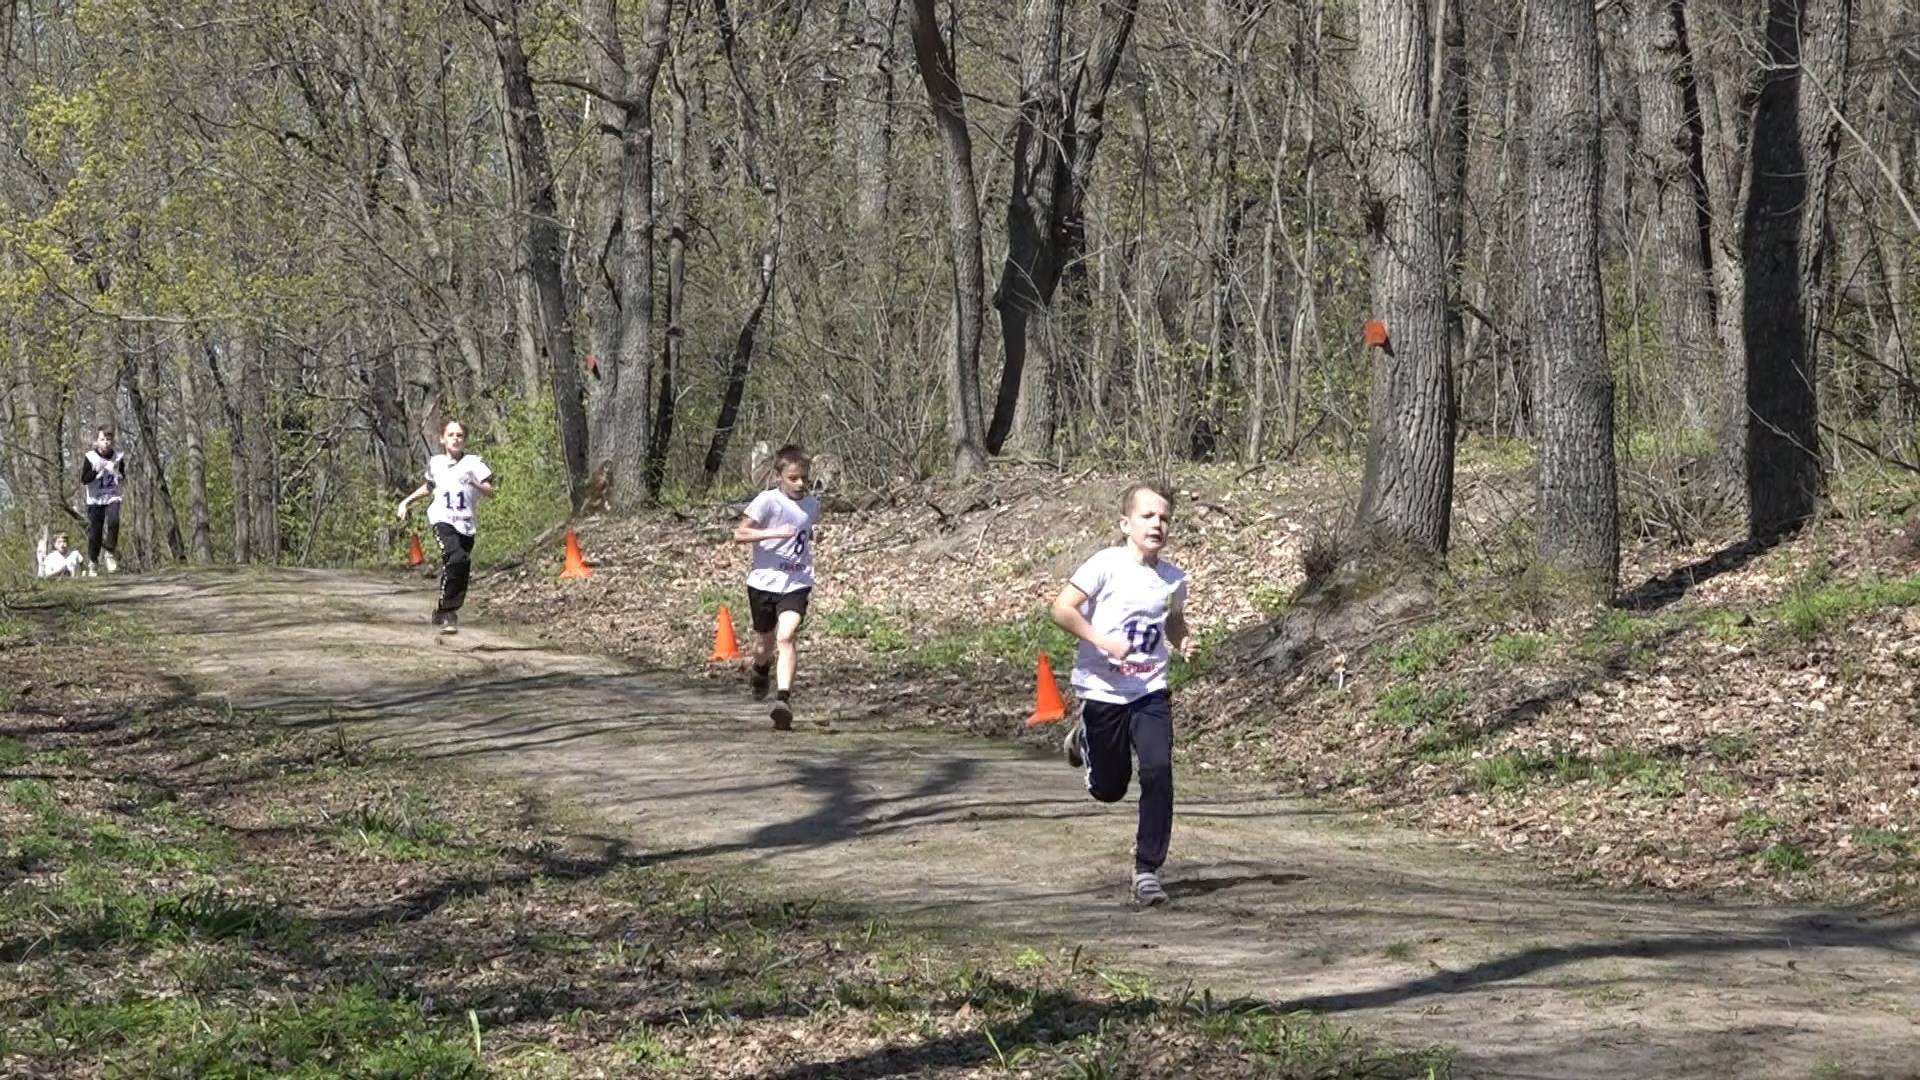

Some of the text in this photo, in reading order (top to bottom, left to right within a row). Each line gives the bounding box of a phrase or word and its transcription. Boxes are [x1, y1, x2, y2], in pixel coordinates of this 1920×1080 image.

[443, 490, 467, 510] 11
[794, 529, 809, 555] 8
[1123, 620, 1161, 654] 10
